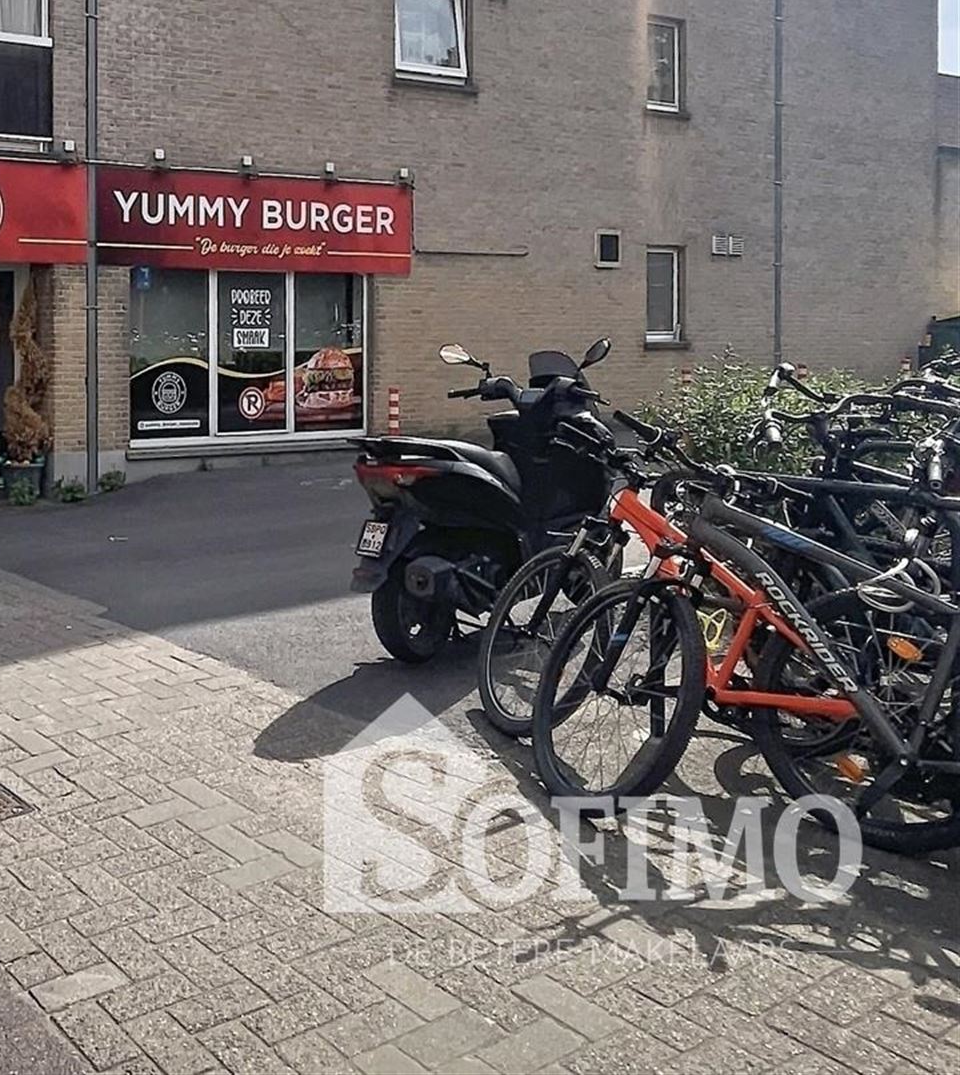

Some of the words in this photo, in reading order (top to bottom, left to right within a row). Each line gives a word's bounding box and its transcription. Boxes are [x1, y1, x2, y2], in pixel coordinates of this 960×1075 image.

[113, 190, 249, 227] YUMMY
[262, 200, 394, 234] BURGER
[220, 241, 258, 257] burger
[261, 244, 279, 255] die
[240, 309, 262, 325] DEZE
[236, 330, 266, 345] SMAAK
[755, 572, 858, 693] ROCKRIDER
